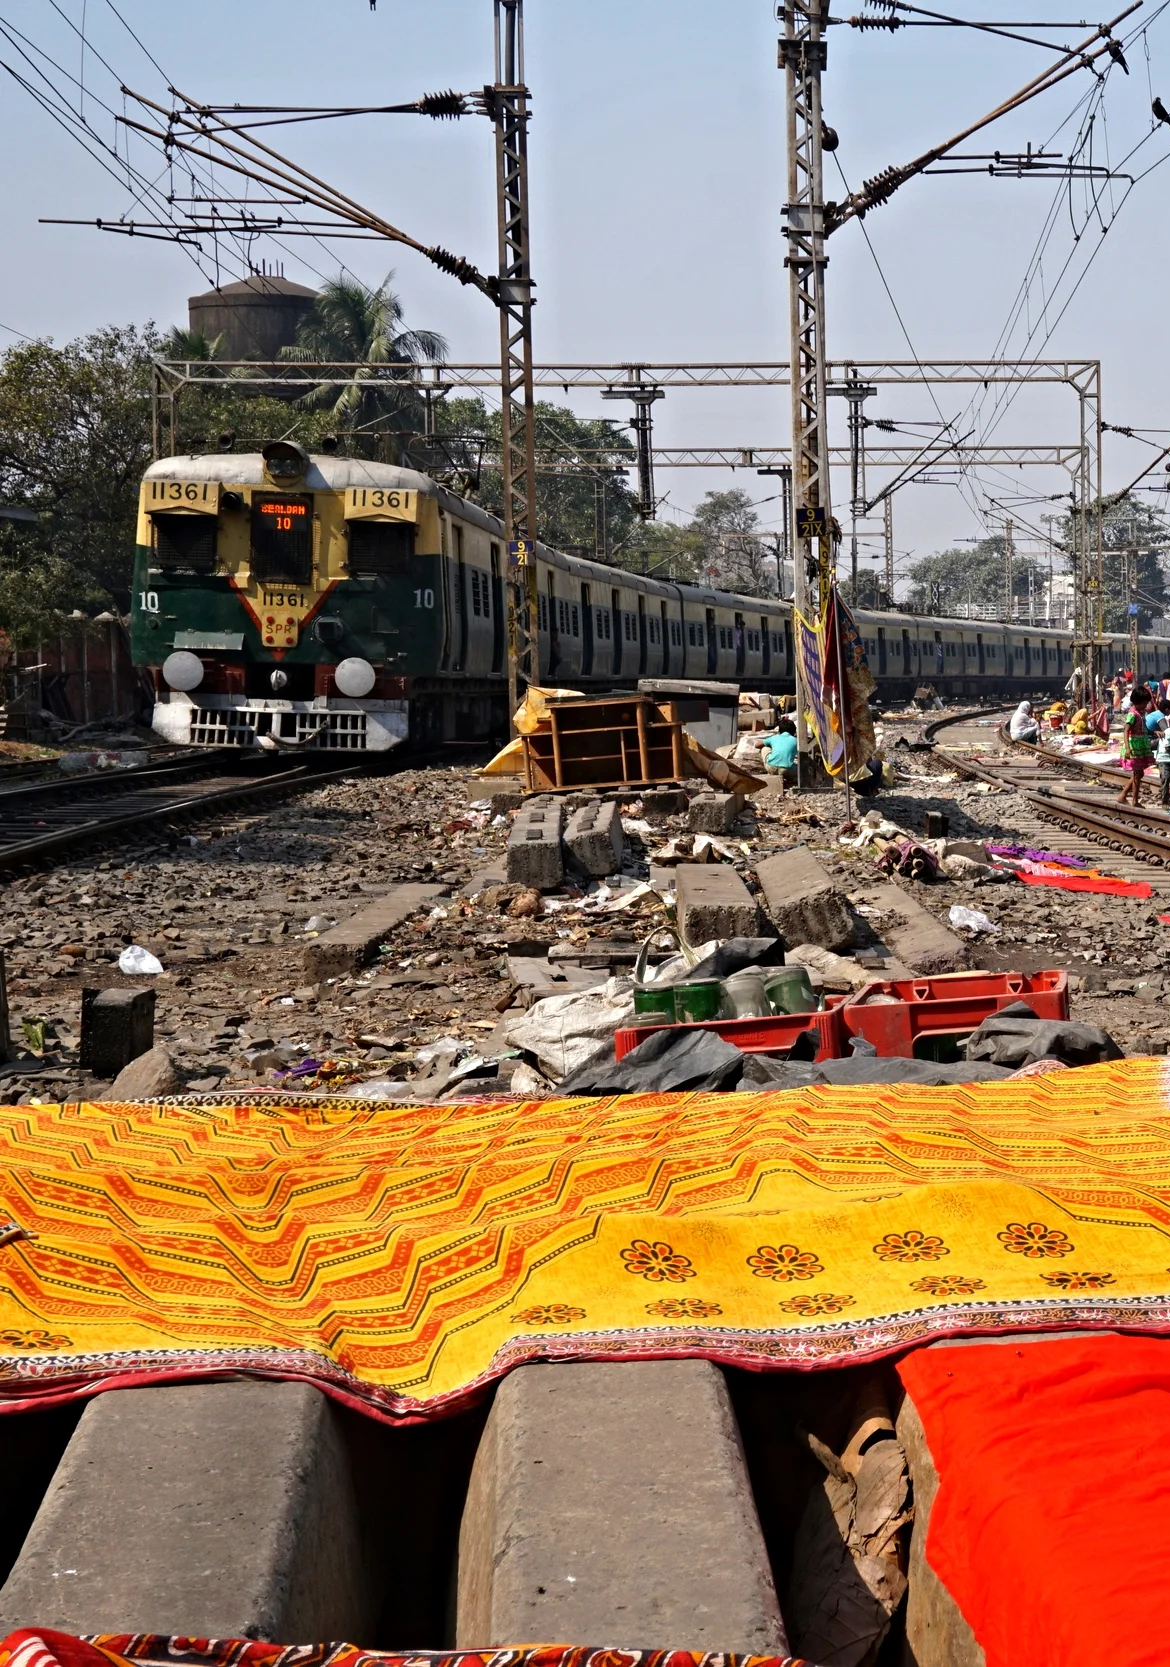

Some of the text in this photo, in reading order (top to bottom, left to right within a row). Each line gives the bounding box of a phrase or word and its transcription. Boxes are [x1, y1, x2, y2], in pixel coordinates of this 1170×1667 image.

[152, 481, 208, 501] 11361
[352, 489, 409, 509] 11361
[807, 509, 815, 521] 9
[276, 517, 291, 530] 10
[802, 523, 822, 536] 21X
[517, 541, 526, 553] 9
[516, 554, 528, 566] 21
[822, 550, 828, 563] 9
[138, 591, 159, 610] 10
[263, 591, 304, 607] 11361
[413, 588, 435, 609] 10
[265, 623, 292, 634] SPR
